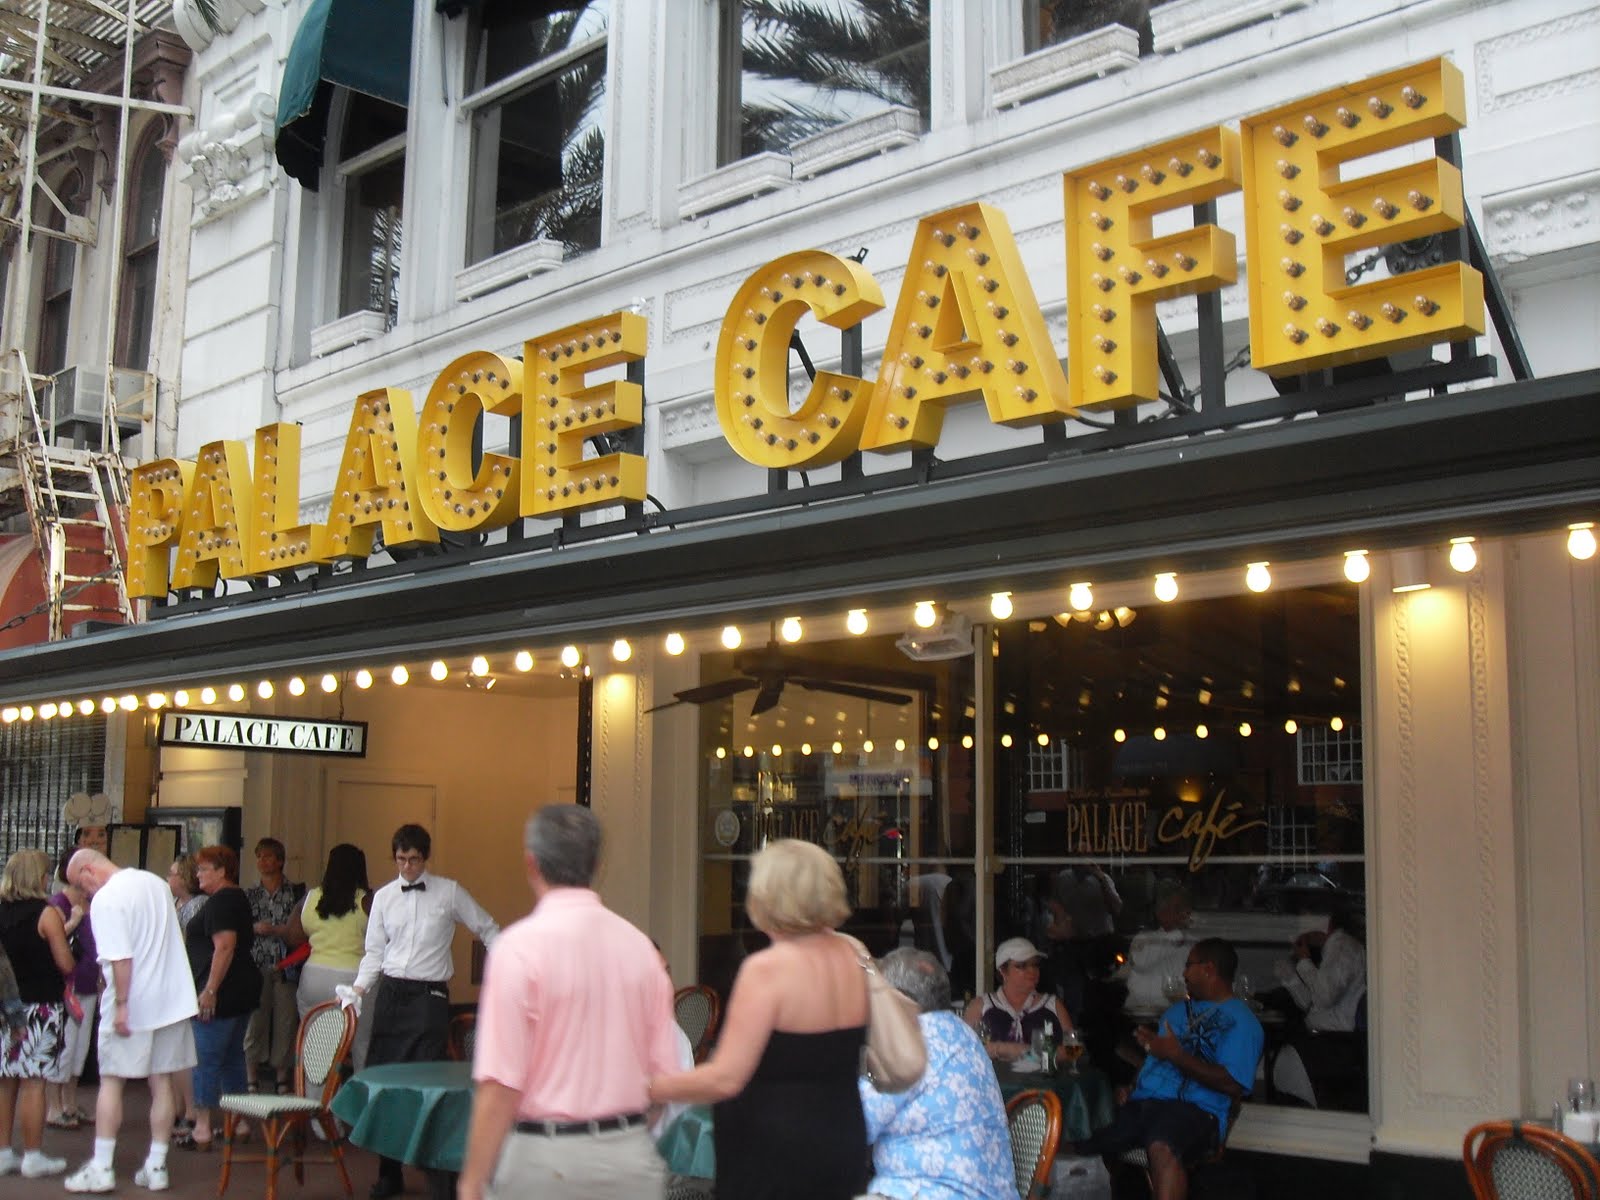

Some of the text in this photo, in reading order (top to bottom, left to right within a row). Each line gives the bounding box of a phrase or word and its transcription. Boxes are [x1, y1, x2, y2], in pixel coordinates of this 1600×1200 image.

[127, 56, 1486, 600] PALACE CAFE
[173, 716, 354, 751] PALACE CAFE
[1067, 788, 1268, 872] PALACE café
